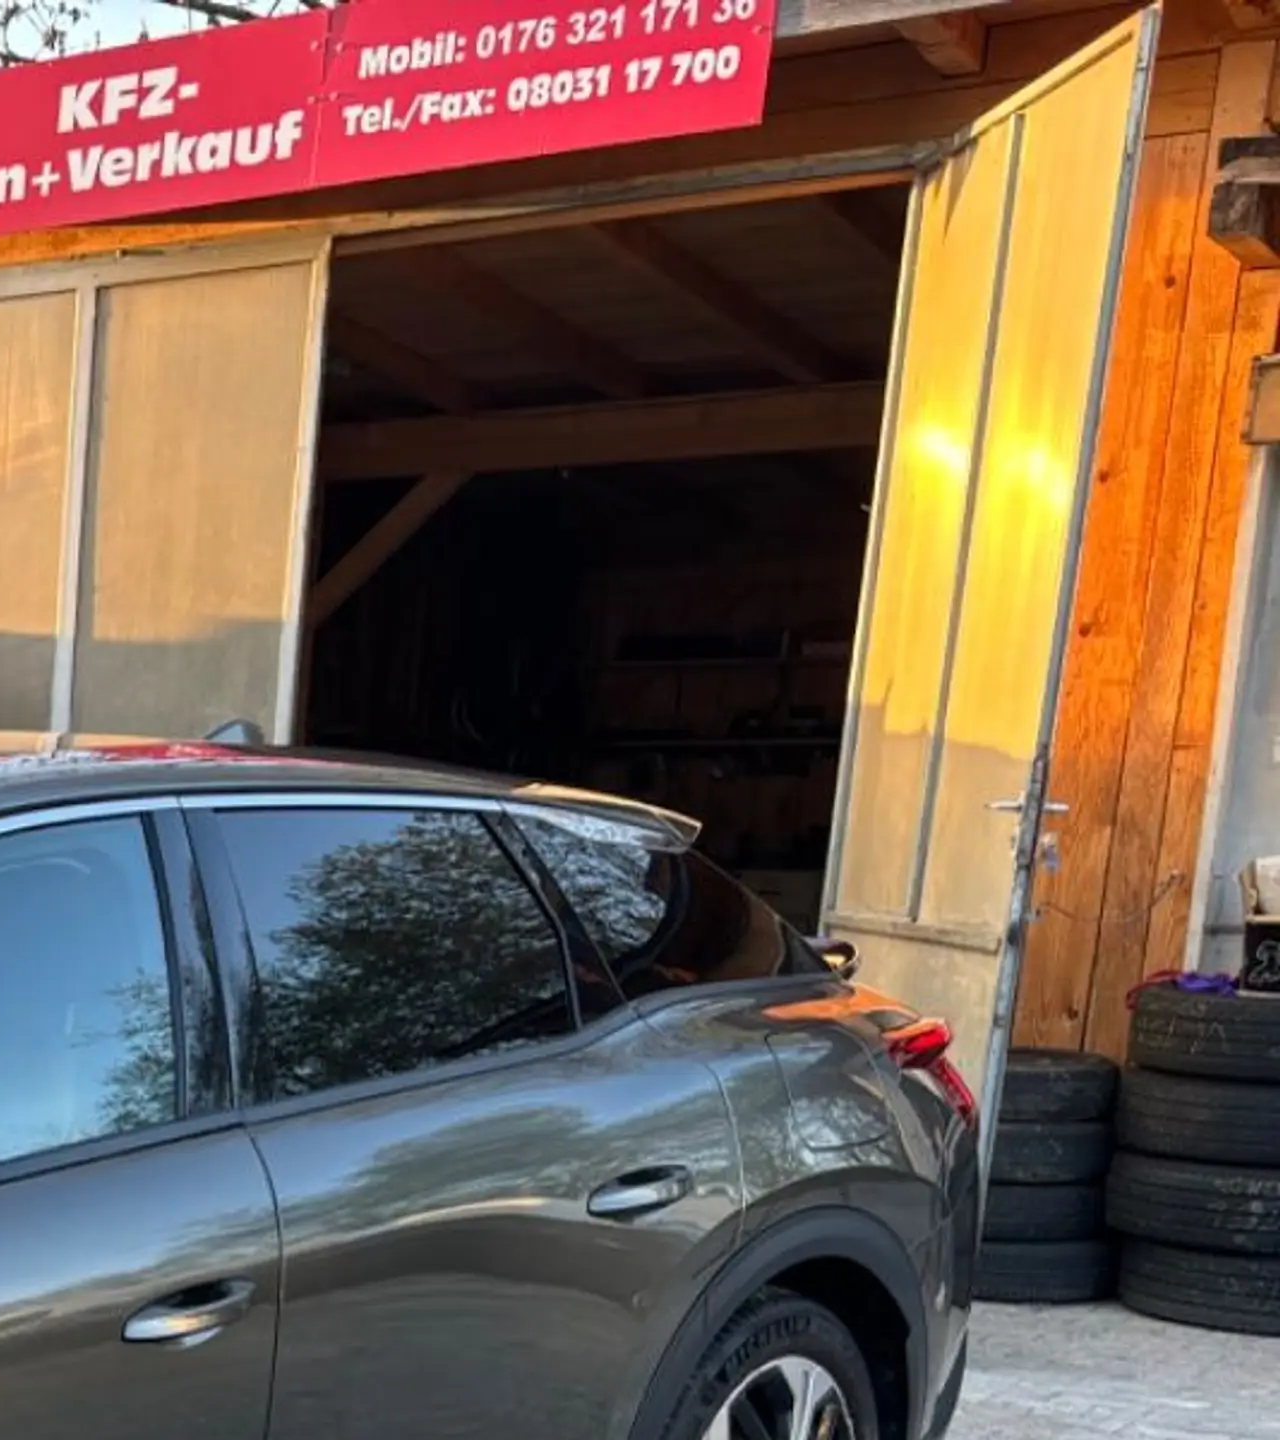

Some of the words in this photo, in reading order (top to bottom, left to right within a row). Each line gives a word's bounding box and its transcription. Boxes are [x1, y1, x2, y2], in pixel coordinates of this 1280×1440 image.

[358, 31, 467, 79] Mobil:
[476, 15, 557, 59] 0176
[566, 5, 627, 44] 321
[640, 0, 699, 34] 171
[57, 66, 200, 134] KFZ-
[343, 87, 497, 136] Tel./Fax:
[506, 64, 612, 112] 08031
[624, 56, 663, 93] 17
[670, 45, 741, 86] 700
